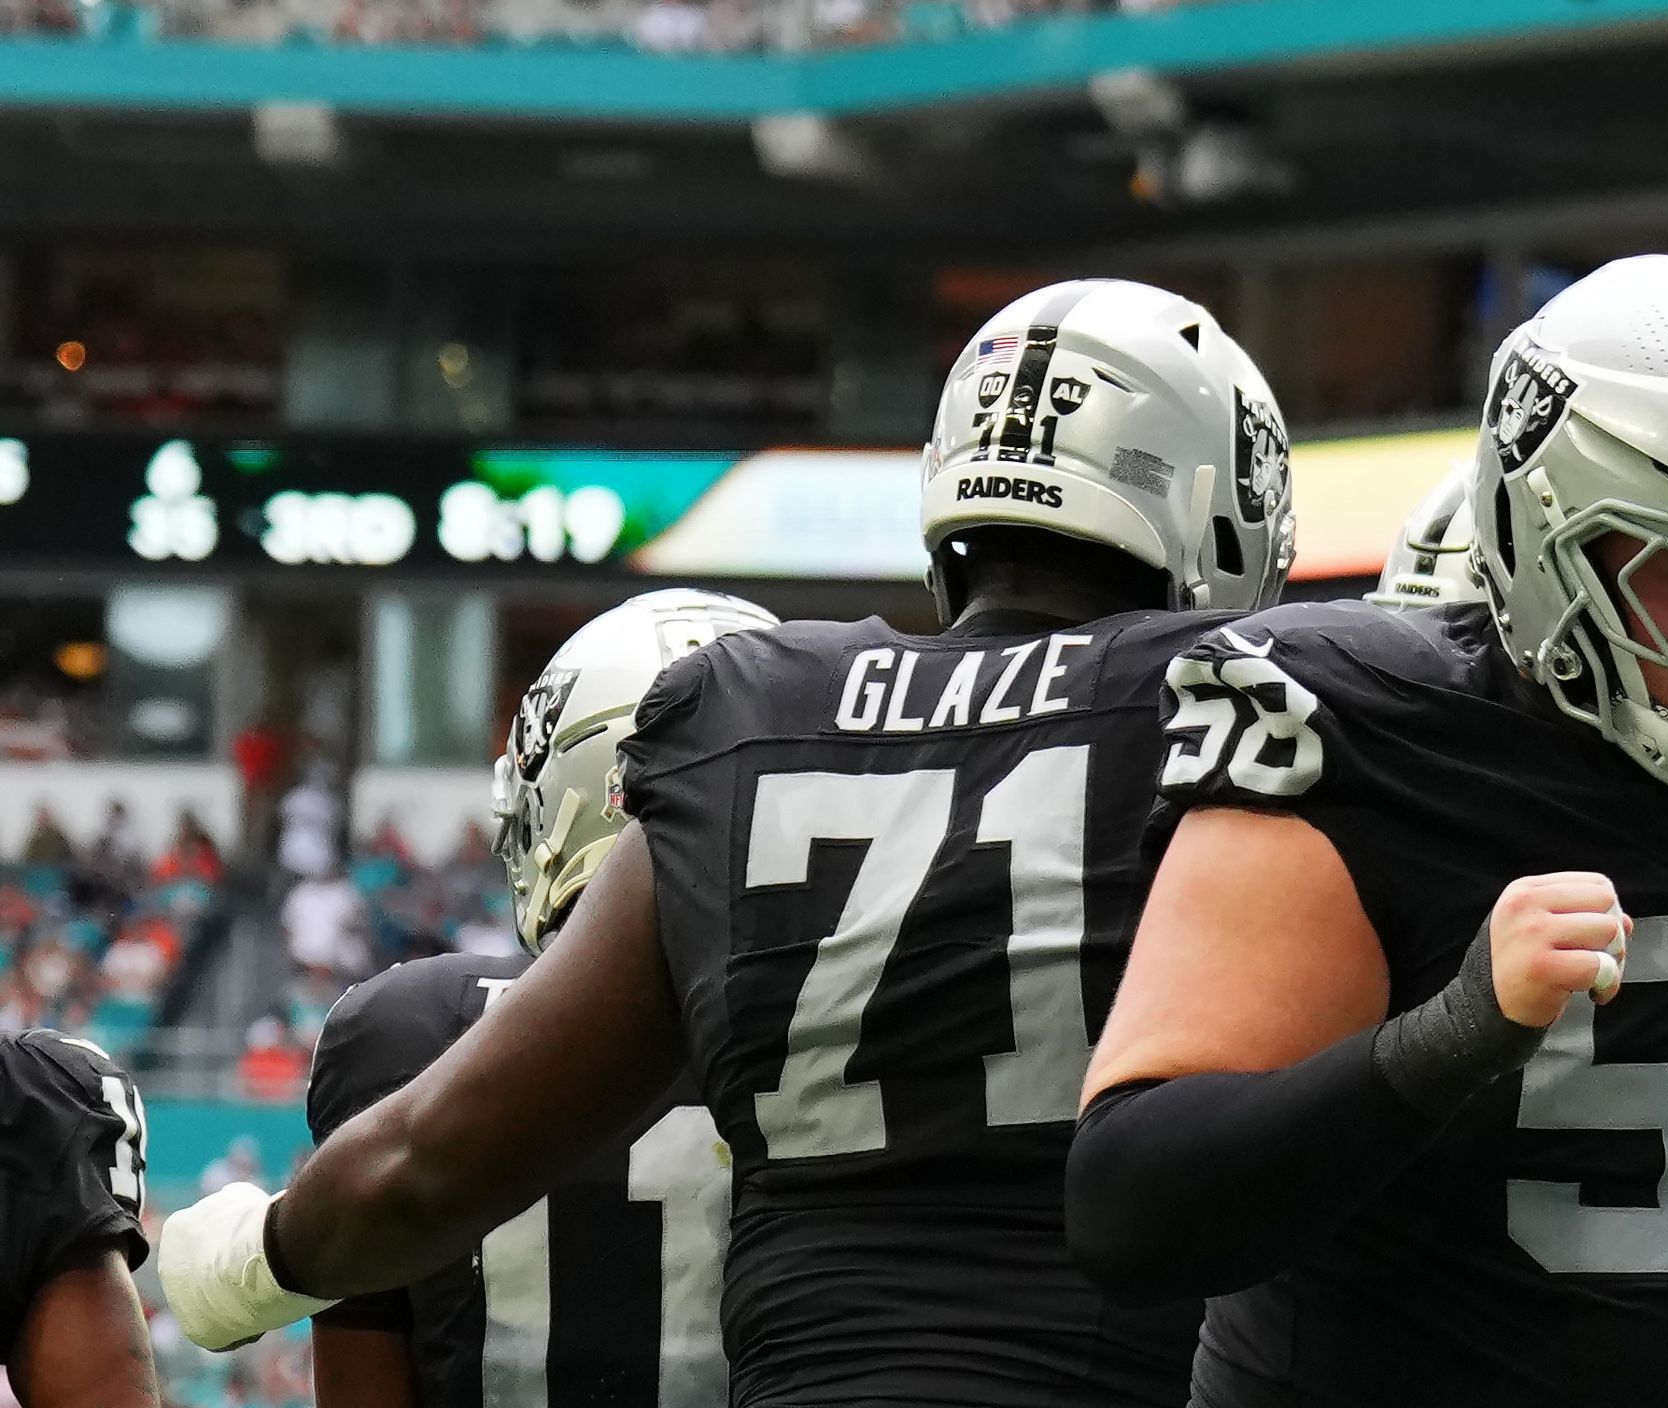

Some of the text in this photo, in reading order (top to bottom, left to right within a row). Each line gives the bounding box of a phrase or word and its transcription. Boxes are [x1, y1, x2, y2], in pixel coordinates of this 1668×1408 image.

[1052, 382, 1084, 404] AL
[970, 411, 1059, 467] 71
[262, 490, 416, 566] 3RD
[956, 476, 1063, 508] RAIDERS
[835, 634, 1093, 732] GLAZE
[1160, 656, 1324, 797] 58
[745, 744, 1096, 1160] 71
